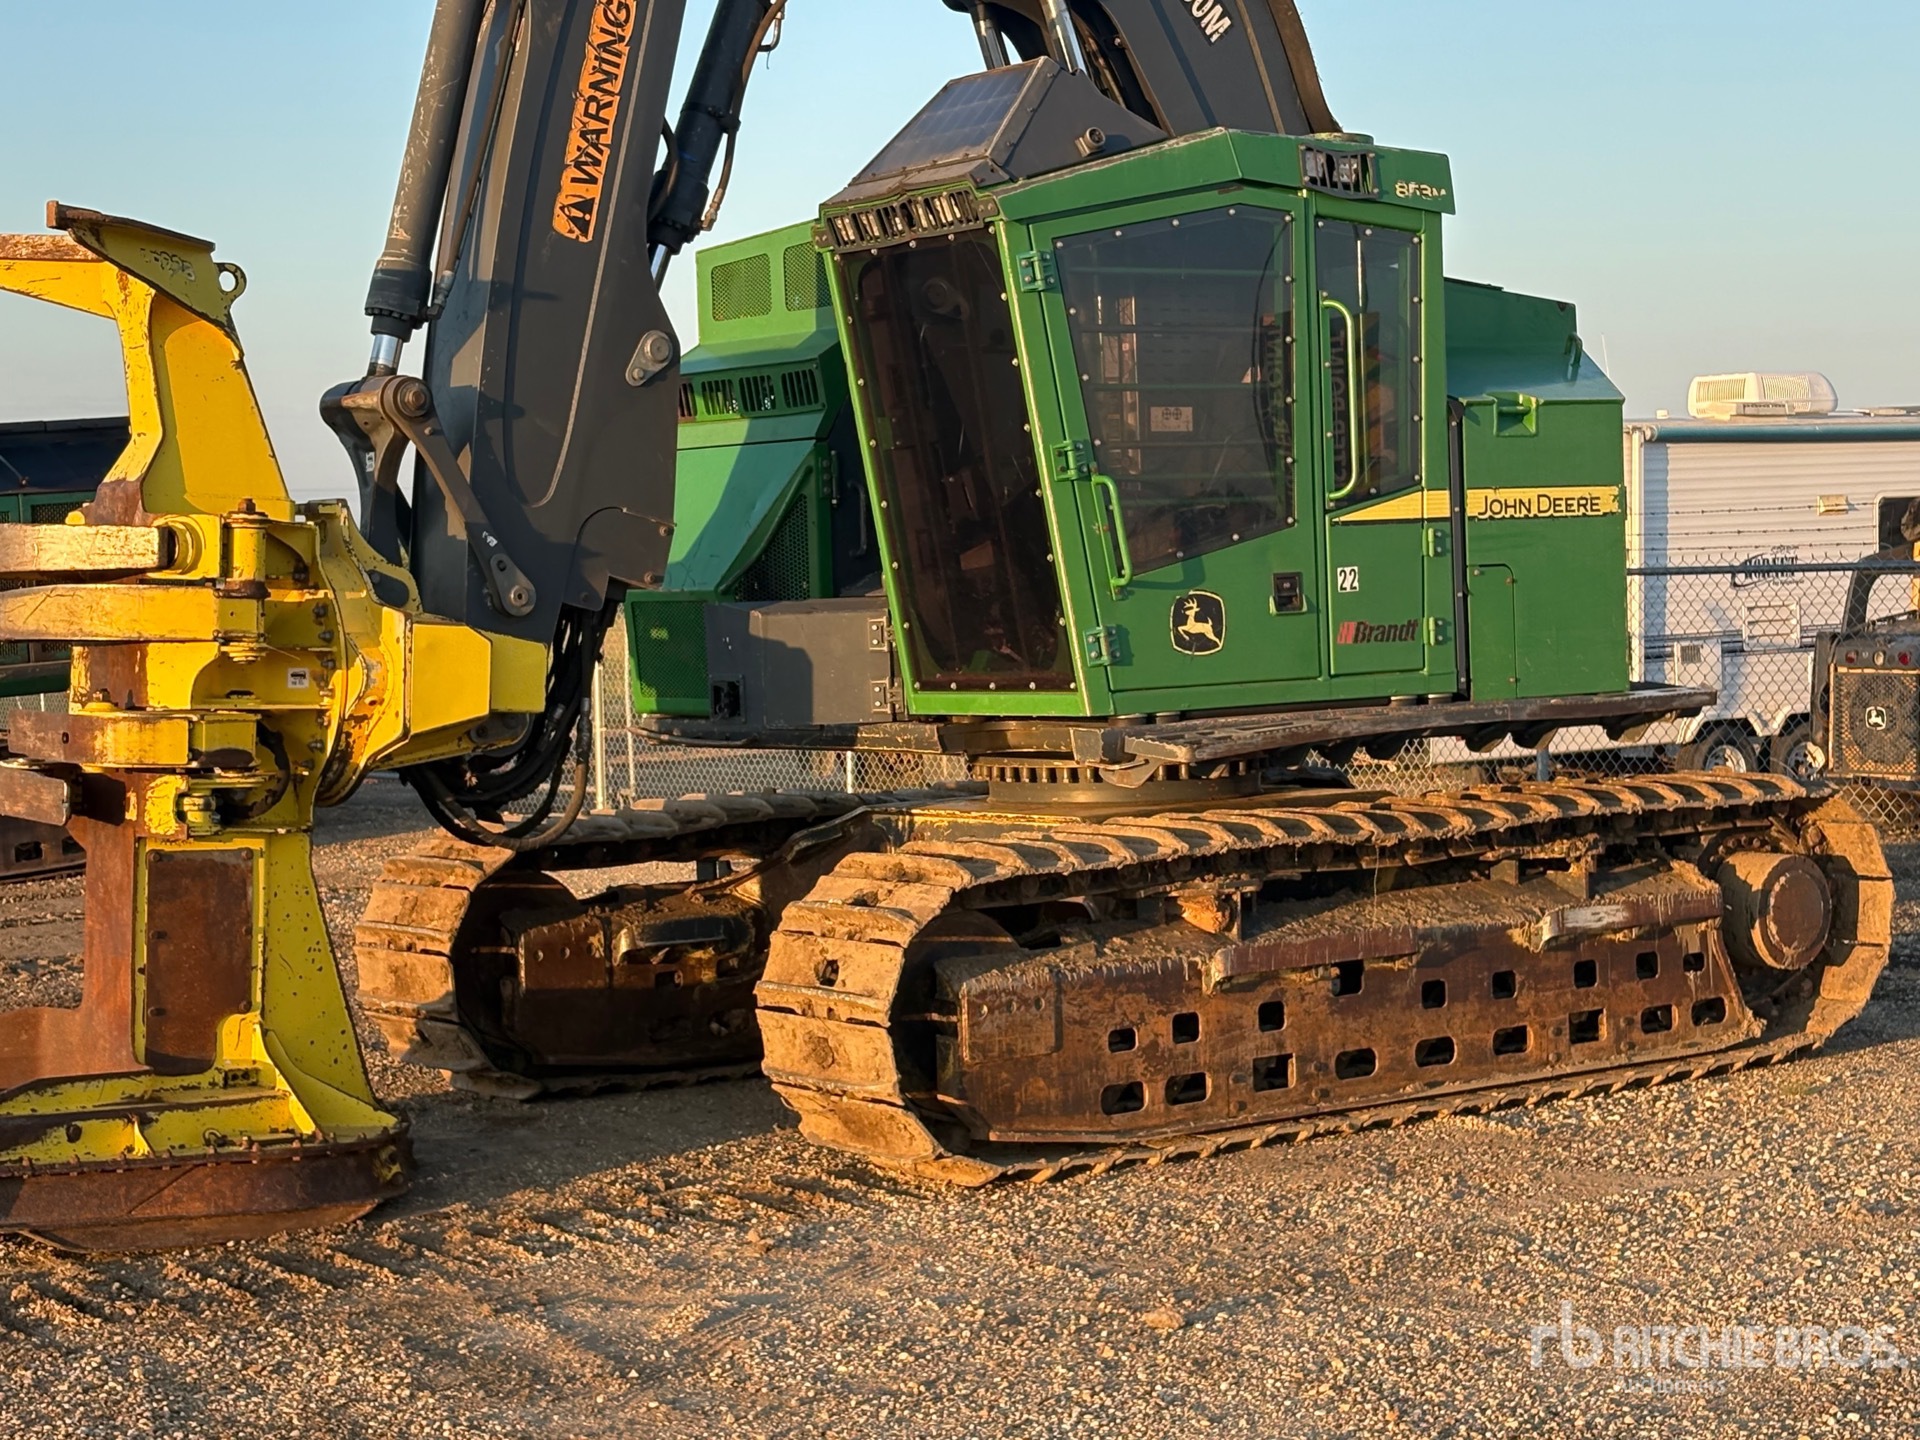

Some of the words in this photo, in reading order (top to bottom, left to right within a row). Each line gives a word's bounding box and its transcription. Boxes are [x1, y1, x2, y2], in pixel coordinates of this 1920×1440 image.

[570, 0, 631, 186] WARNING
[1478, 495, 1532, 516] JOHN
[1536, 494, 1601, 514] DEERE
[1339, 568, 1358, 591] 22
[1353, 619, 1419, 644] Brandt
